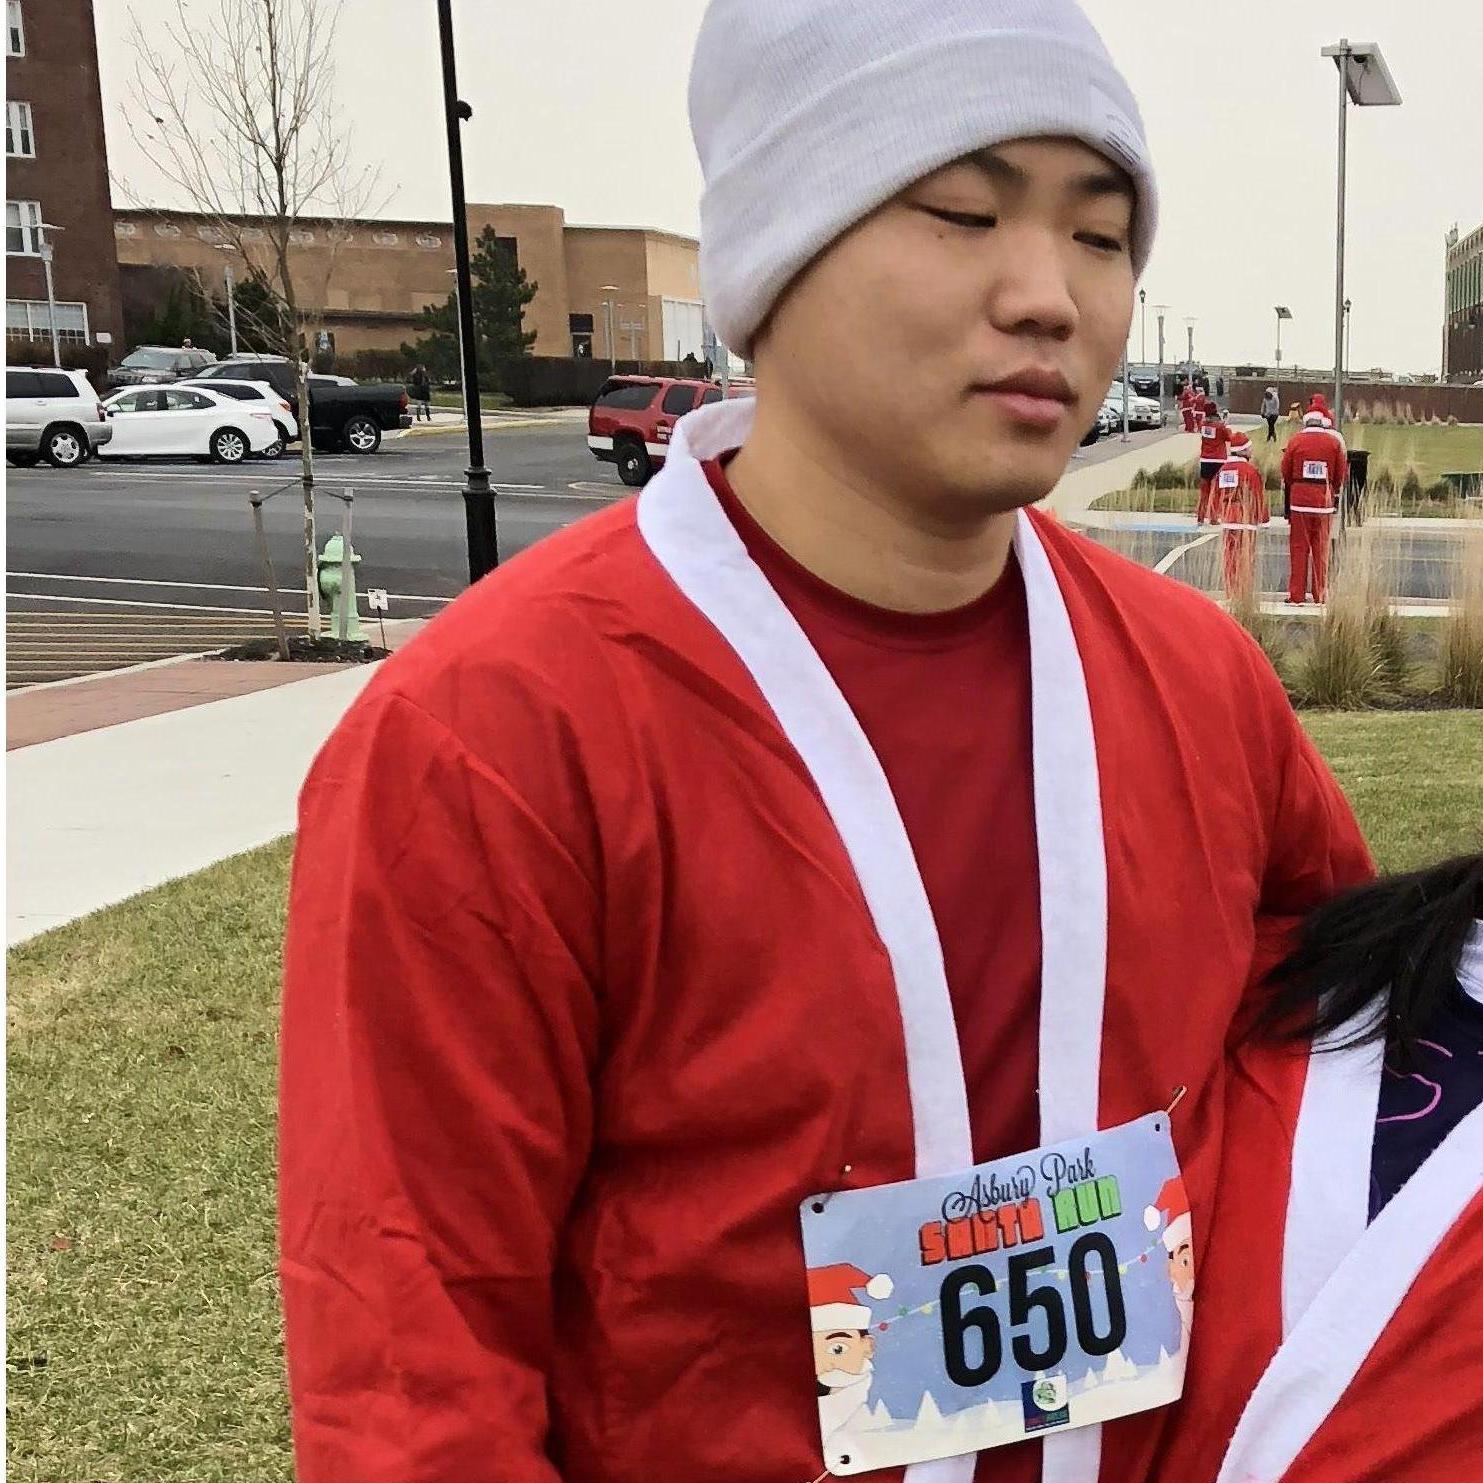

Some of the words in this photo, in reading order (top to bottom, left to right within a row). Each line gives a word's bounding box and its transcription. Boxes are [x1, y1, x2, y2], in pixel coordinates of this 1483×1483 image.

[919, 1197, 1045, 1266] SANTA
[1051, 1174, 1122, 1234] RUN
[941, 1164, 1037, 1222] Asbury
[1040, 1147, 1095, 1197] Park
[940, 1231, 1127, 1388] 650
